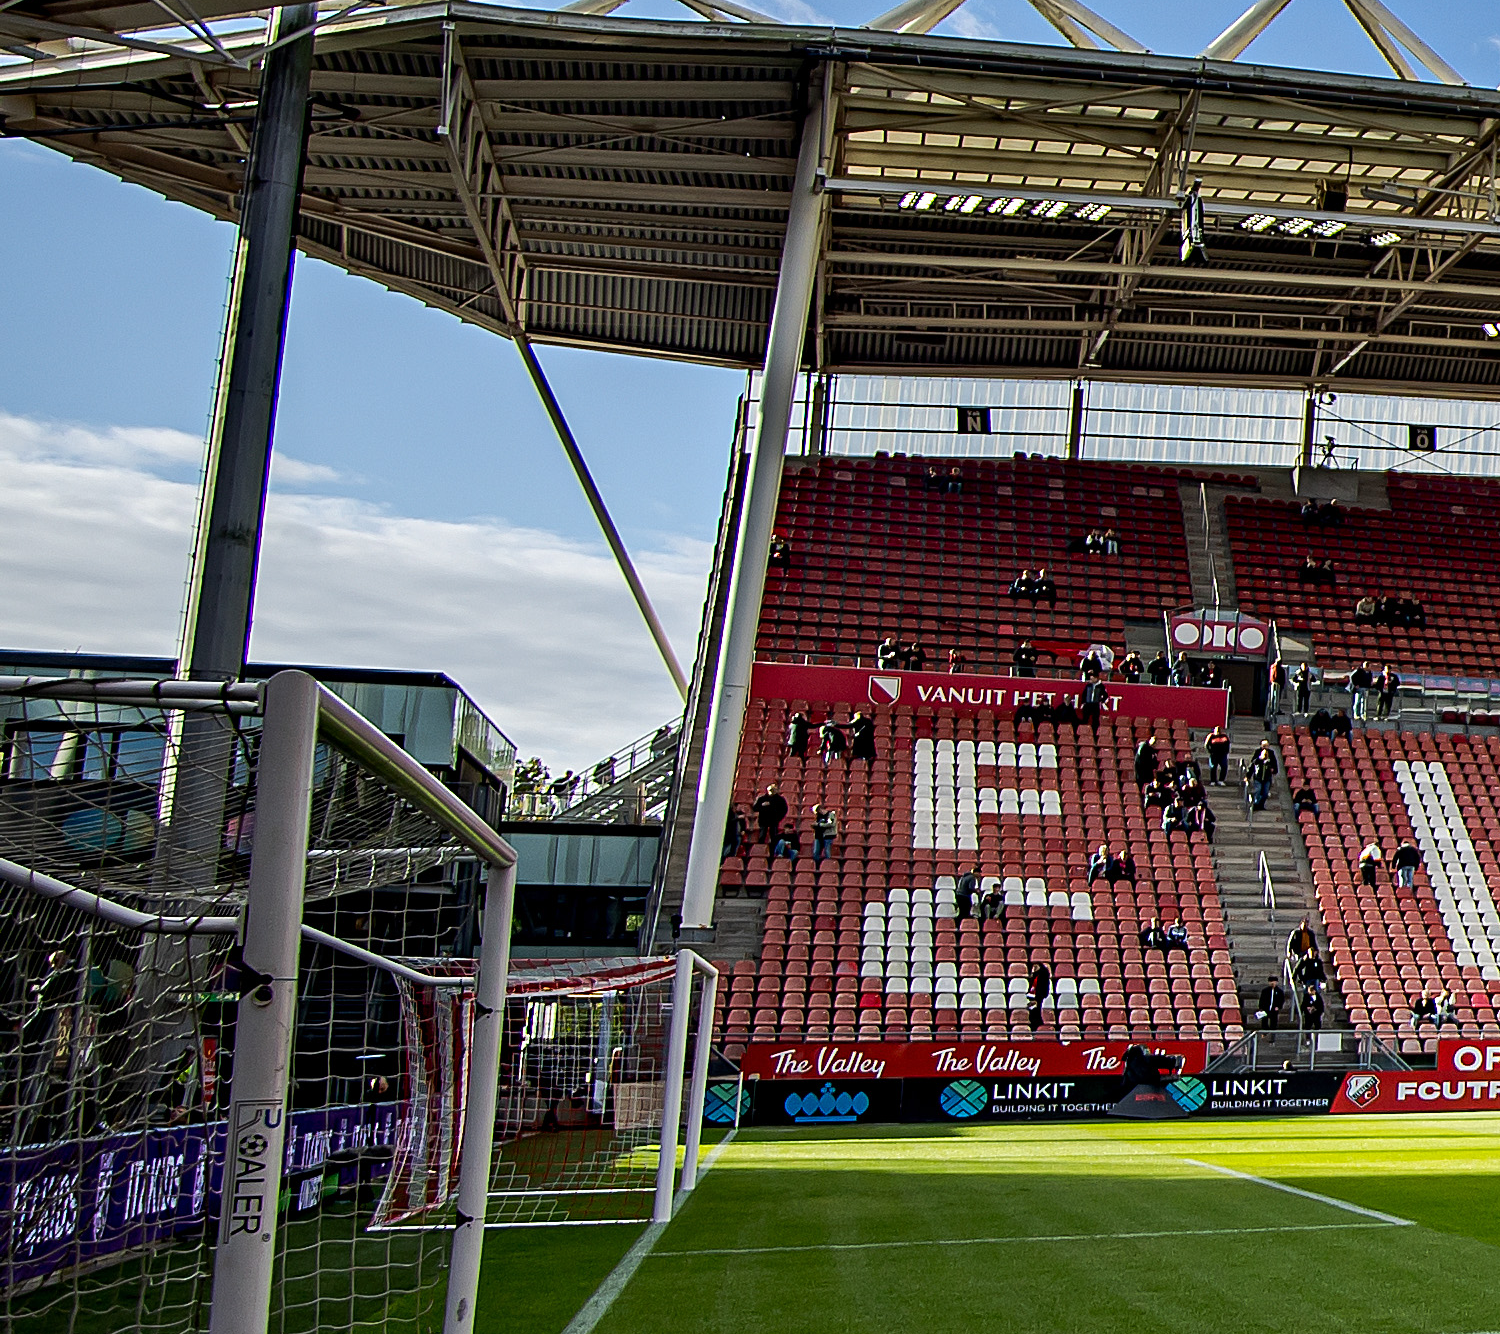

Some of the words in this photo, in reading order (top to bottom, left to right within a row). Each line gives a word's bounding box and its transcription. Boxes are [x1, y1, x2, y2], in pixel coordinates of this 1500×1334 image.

[967, 416, 982, 432] N
[917, 685, 1002, 705] VANUIT
[770, 1047, 813, 1075] The
[816, 1046, 886, 1078] Valley
[931, 1047, 973, 1073] The
[975, 1044, 1041, 1077] Valley
[1083, 1046, 1121, 1070] The
[993, 1082, 1075, 1100] LINKIT
[1212, 1079, 1287, 1097] LINKIT
[993, 1104, 1045, 1114] BUILDING
[1047, 1104, 1058, 1113] IT
[1211, 1100, 1260, 1109] BUILDING
[1262, 1099, 1273, 1108] IT
[1275, 1098, 1329, 1108] TOGETHER
